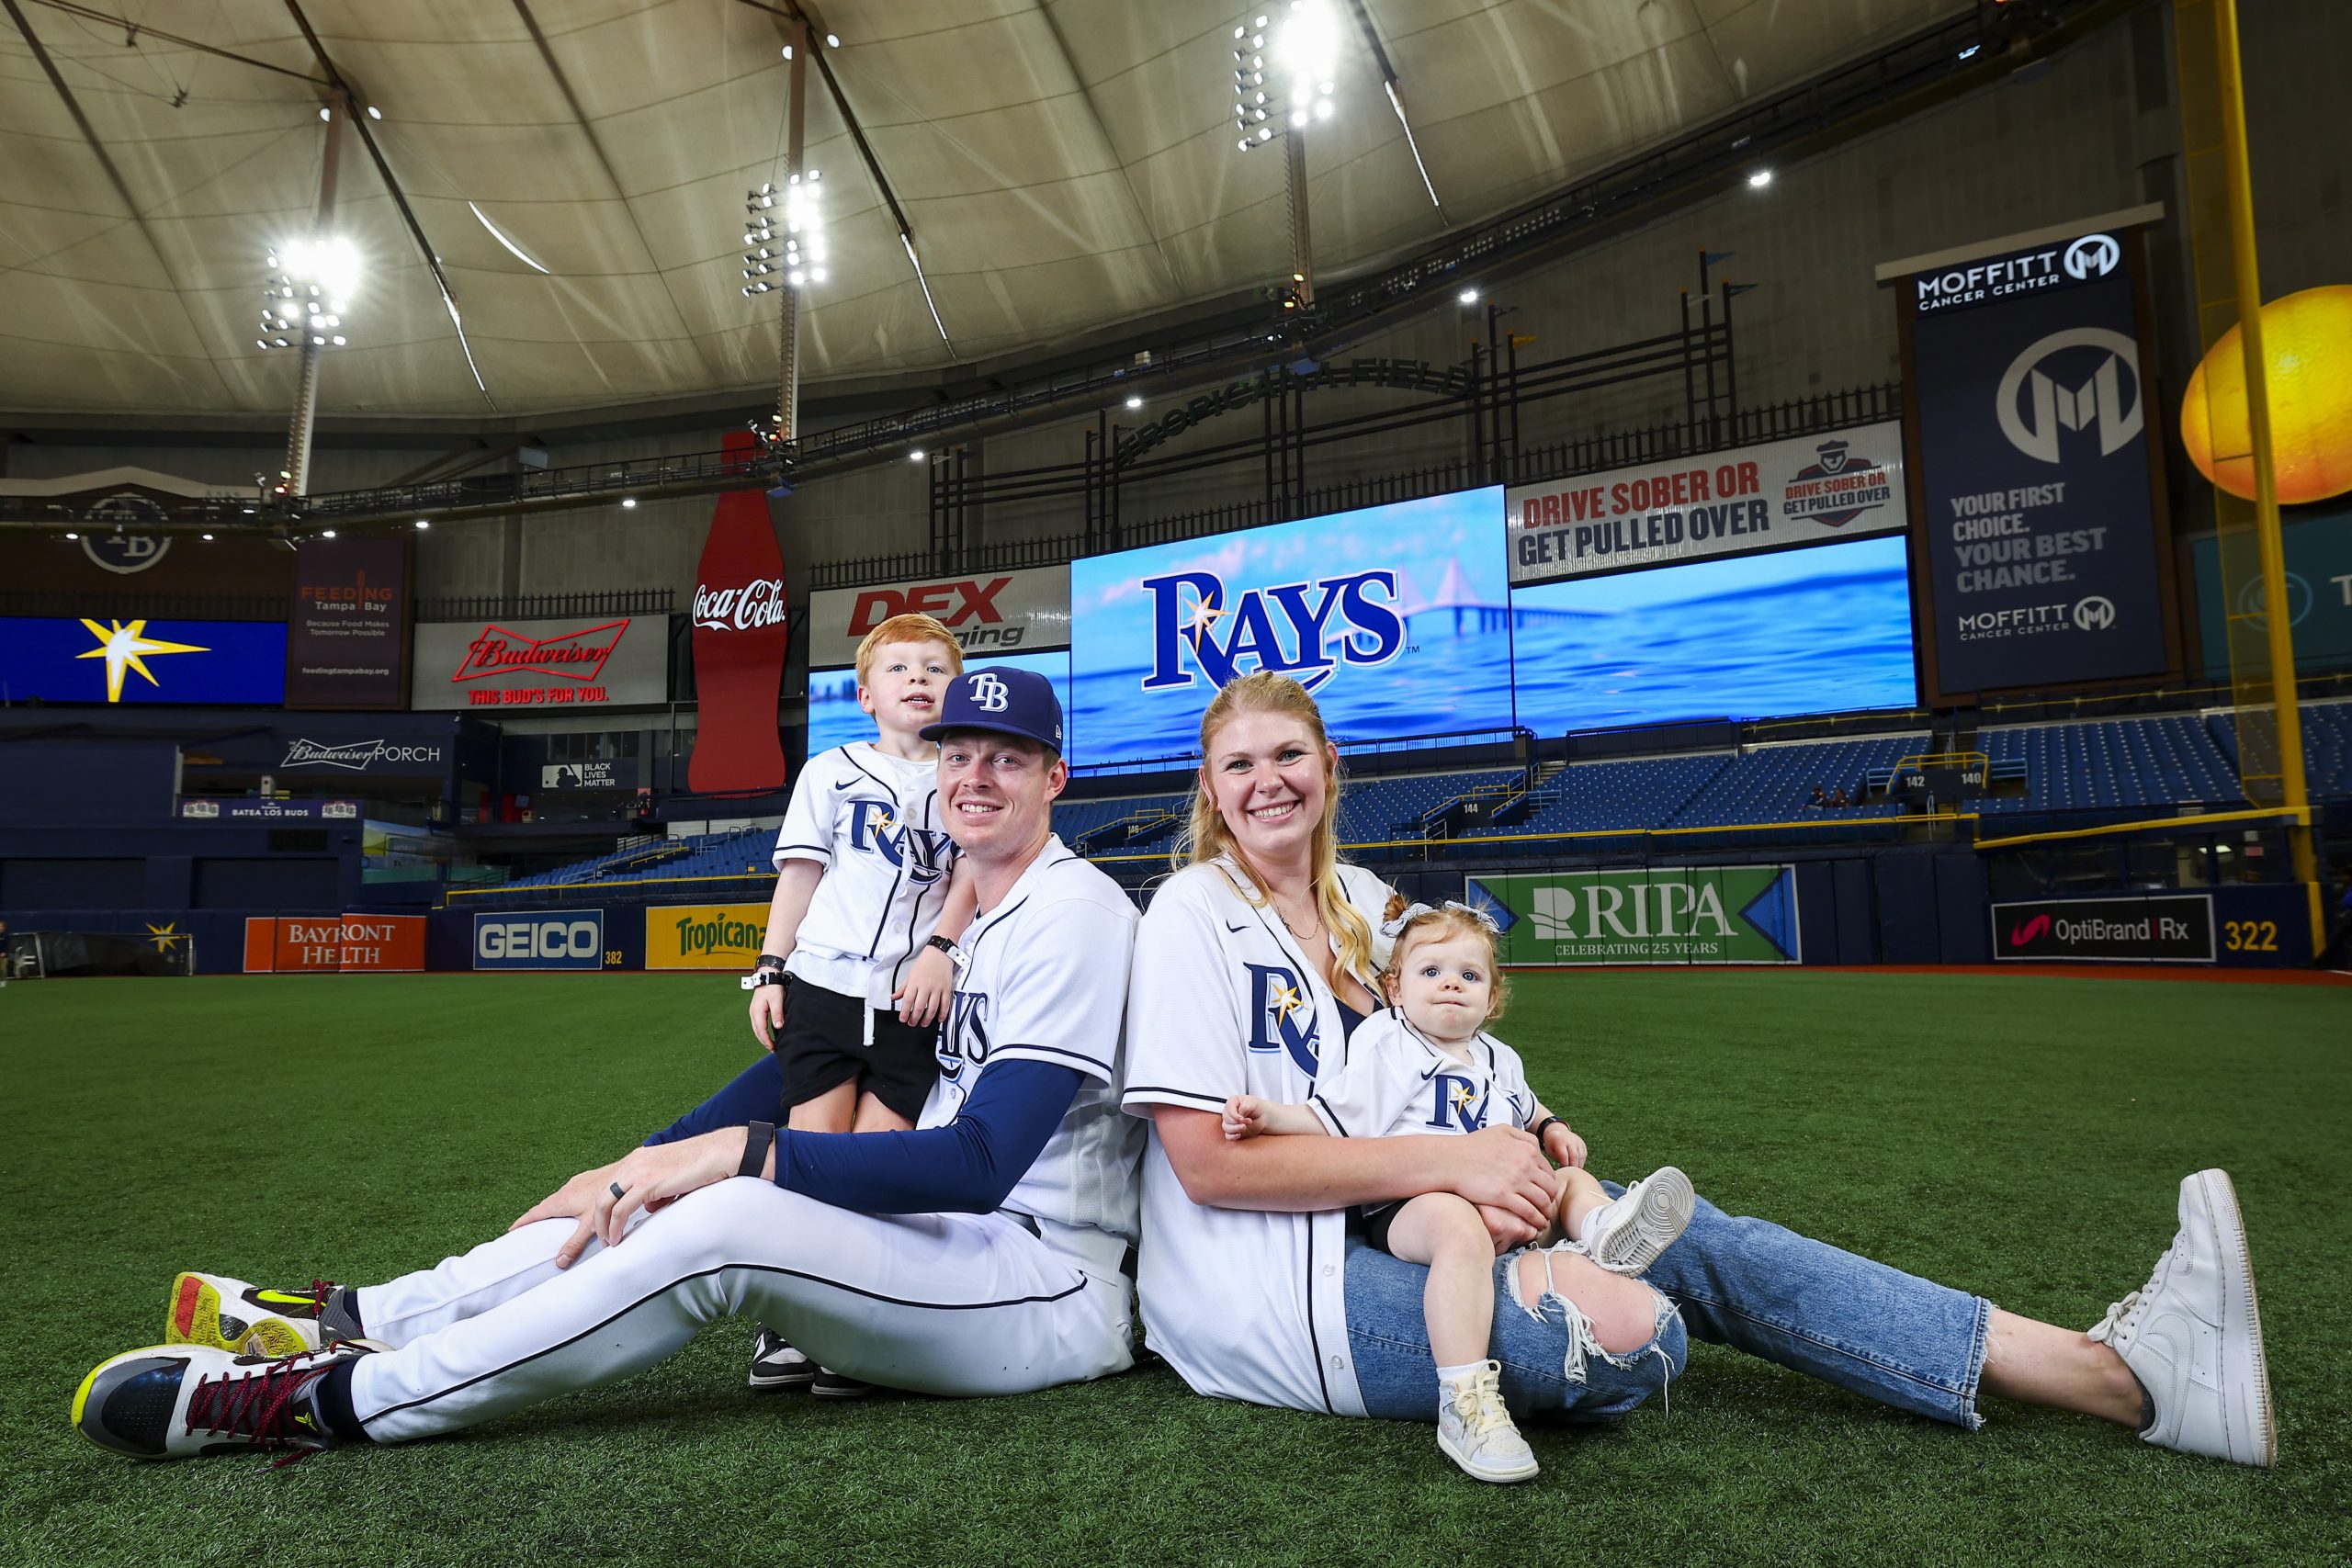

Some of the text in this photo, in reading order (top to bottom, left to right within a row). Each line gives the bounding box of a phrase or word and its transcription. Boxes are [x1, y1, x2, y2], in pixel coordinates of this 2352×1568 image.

[1917, 250, 2058, 299] MOFFITT
[1918, 273, 2061, 311] CANCER CENTER
[1349, 358, 1478, 398] FIELD
[1523, 461, 1760, 530] DRIVE SOBER OR
[1785, 471, 1886, 500] DRIVE SOBER OR
[1950, 481, 2065, 518] YOUR FIRST
[1783, 486, 1891, 514] GET PULLED OVER
[1518, 498, 1770, 567] GET PULLED OVER
[1952, 513, 2030, 542] CHOICE.
[1954, 526, 2107, 568] YOUR BEST
[1956, 558, 2076, 593] CHANCE.
[300, 586, 395, 602] FEEDING
[314, 601, 387, 612] Tampa Bay
[693, 579, 784, 631] Coca-Cola
[847, 577, 1013, 637] DEX
[1141, 568, 1408, 695] RAYS
[1958, 604, 2067, 632] MOFFITT
[1960, 622, 2070, 641] CANCER CENTER
[955, 625, 1025, 649] ging
[469, 638, 610, 668] Budweiser
[301, 667, 389, 675] feedingtampabay.org
[469, 686, 609, 705] THIS BUD'S FOR YOU.
[967, 671, 1010, 713] TB
[290, 745, 376, 761] Budweiser
[374, 746, 440, 761] PORCH
[584, 762, 611, 771] BLACK
[583, 771, 606, 779] LIVES
[583, 779, 616, 787] MATTER
[1905, 772, 1982, 787] 142 140
[1464, 803, 1478, 814] 144
[1581, 882, 1739, 939] RIPA
[478, 920, 599, 959] GEICO
[2055, 918, 2189, 945] OptiBrand Rx
[2224, 920, 2278, 951] 322
[302, 946, 380, 964] HELTH
[605, 950, 623, 965] 382
[1555, 942, 1718, 956] CELEBRATING 25 YEARS
